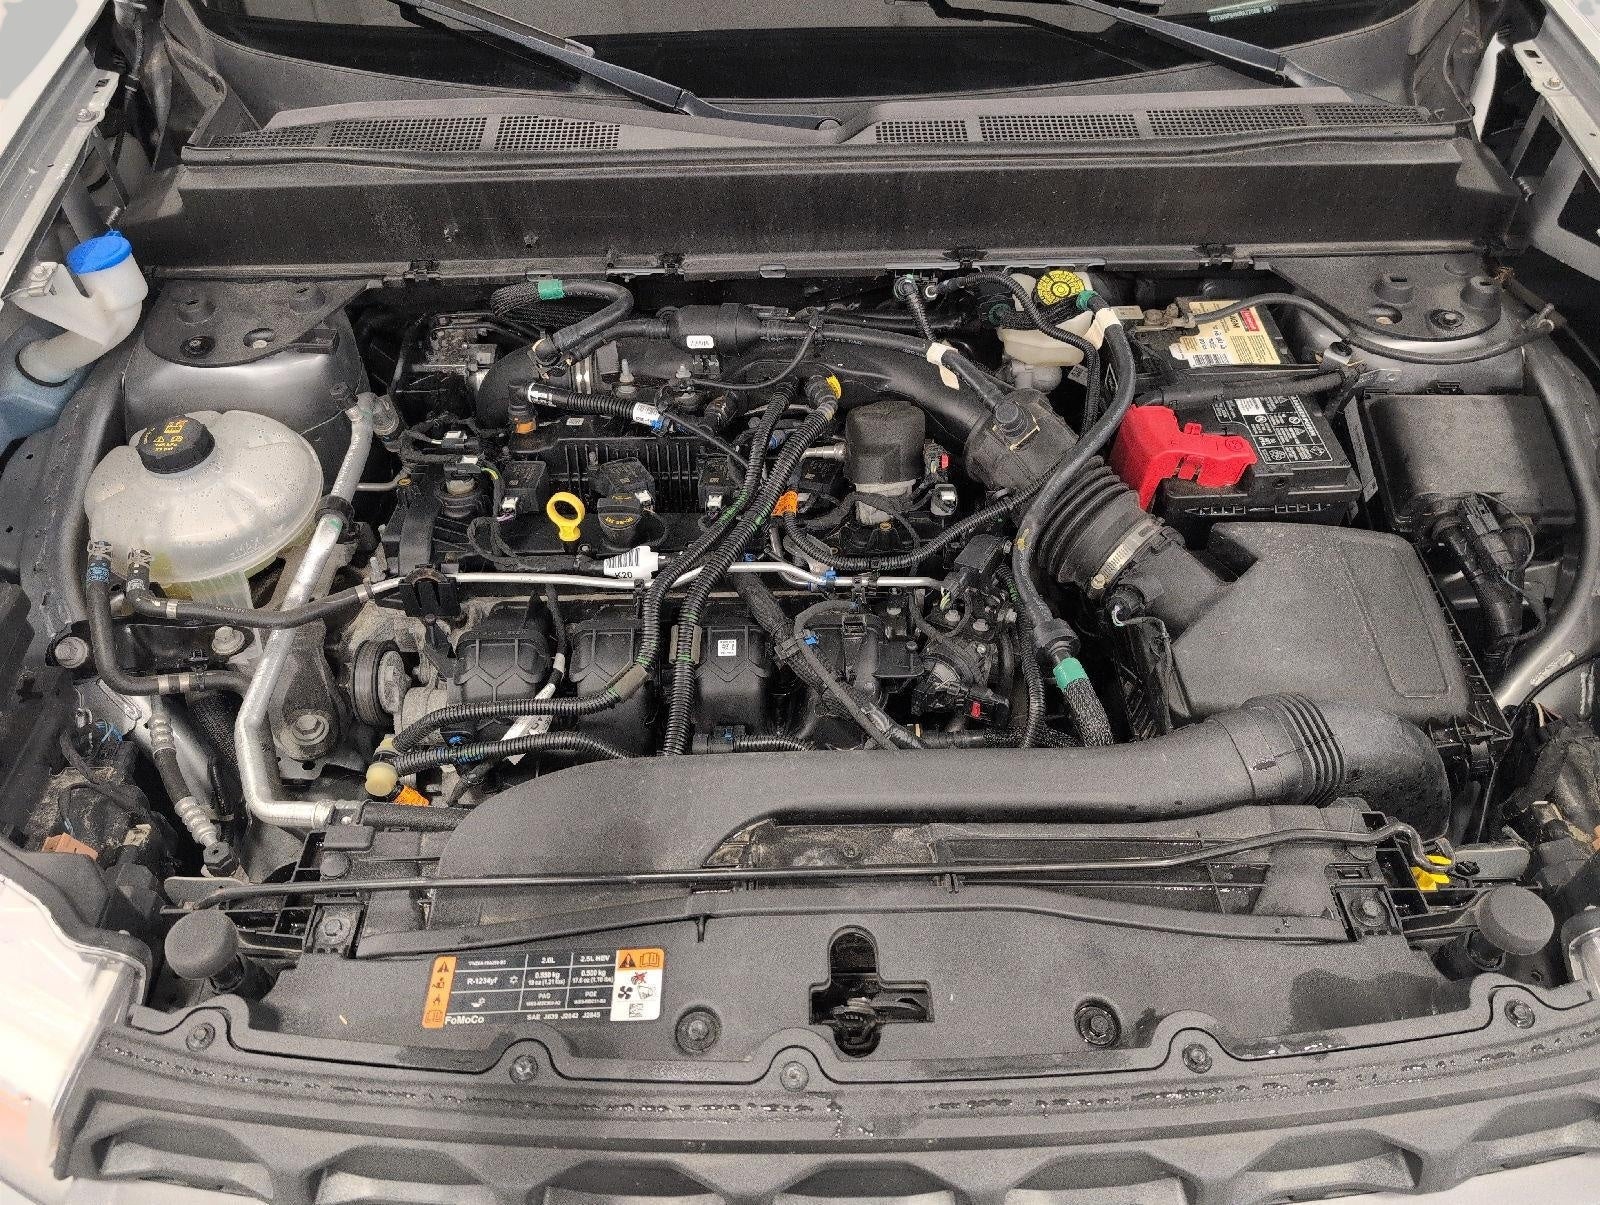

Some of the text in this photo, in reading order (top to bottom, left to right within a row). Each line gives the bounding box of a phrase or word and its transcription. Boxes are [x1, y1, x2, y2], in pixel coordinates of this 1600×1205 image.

[580, 955, 595, 963] 2.5L
[466, 976, 498, 986] R-1234yf
[444, 1014, 486, 1025] FoMoCo
[526, 1013, 541, 1021] SAE
